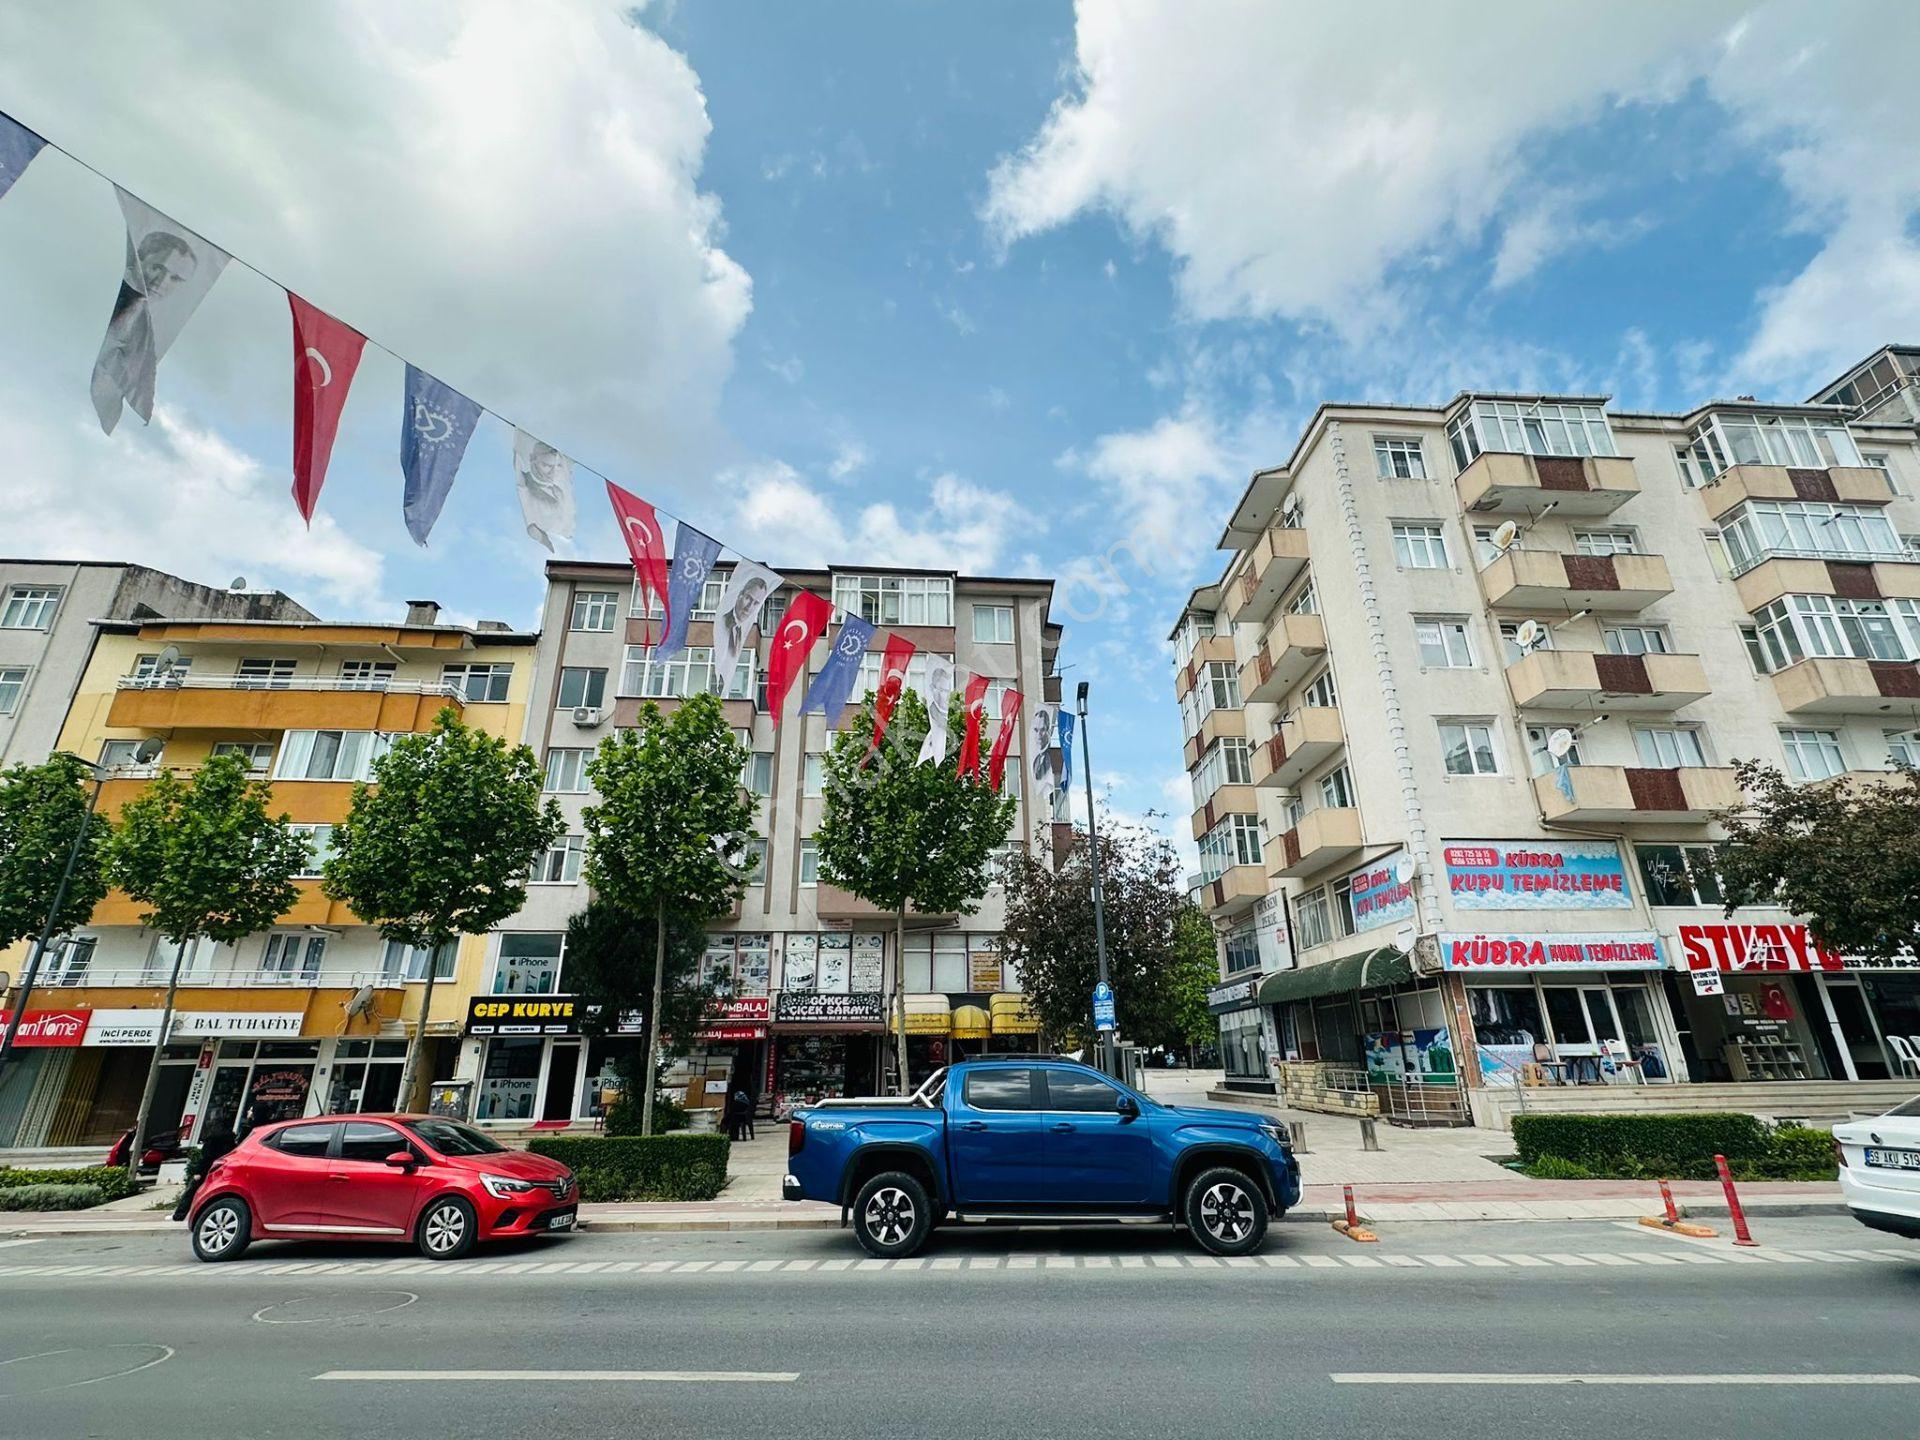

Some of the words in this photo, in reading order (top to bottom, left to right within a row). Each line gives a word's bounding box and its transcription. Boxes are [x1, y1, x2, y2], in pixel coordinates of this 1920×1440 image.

[1506, 850, 1564, 868] KÜBRA
[1451, 874, 1504, 891] KURU
[1511, 869, 1623, 892] TEMİZLEME
[1452, 935, 1547, 967] KÜBRA
[1549, 945, 1583, 962] KURU
[1586, 940, 1659, 962] TEMİZLEME
[518, 958, 548, 967] iPhone
[1099, 985, 1106, 998] P
[721, 1002, 767, 1012] AMBALAJ
[811, 995, 849, 1006] GÖKÇE
[474, 1003, 510, 1017] CEP
[513, 1003, 573, 1016] KURYE
[195, 1018, 223, 1029] BAL
[227, 1016, 300, 1030] TUHAFİYE
[100, 1029, 120, 1037] İNCİ
[499, 1080, 531, 1089] iPhone
[1870, 1150, 1880, 1162] 59
[1884, 1152, 1899, 1164] AKU
[1903, 1153, 1920, 1166] 519
